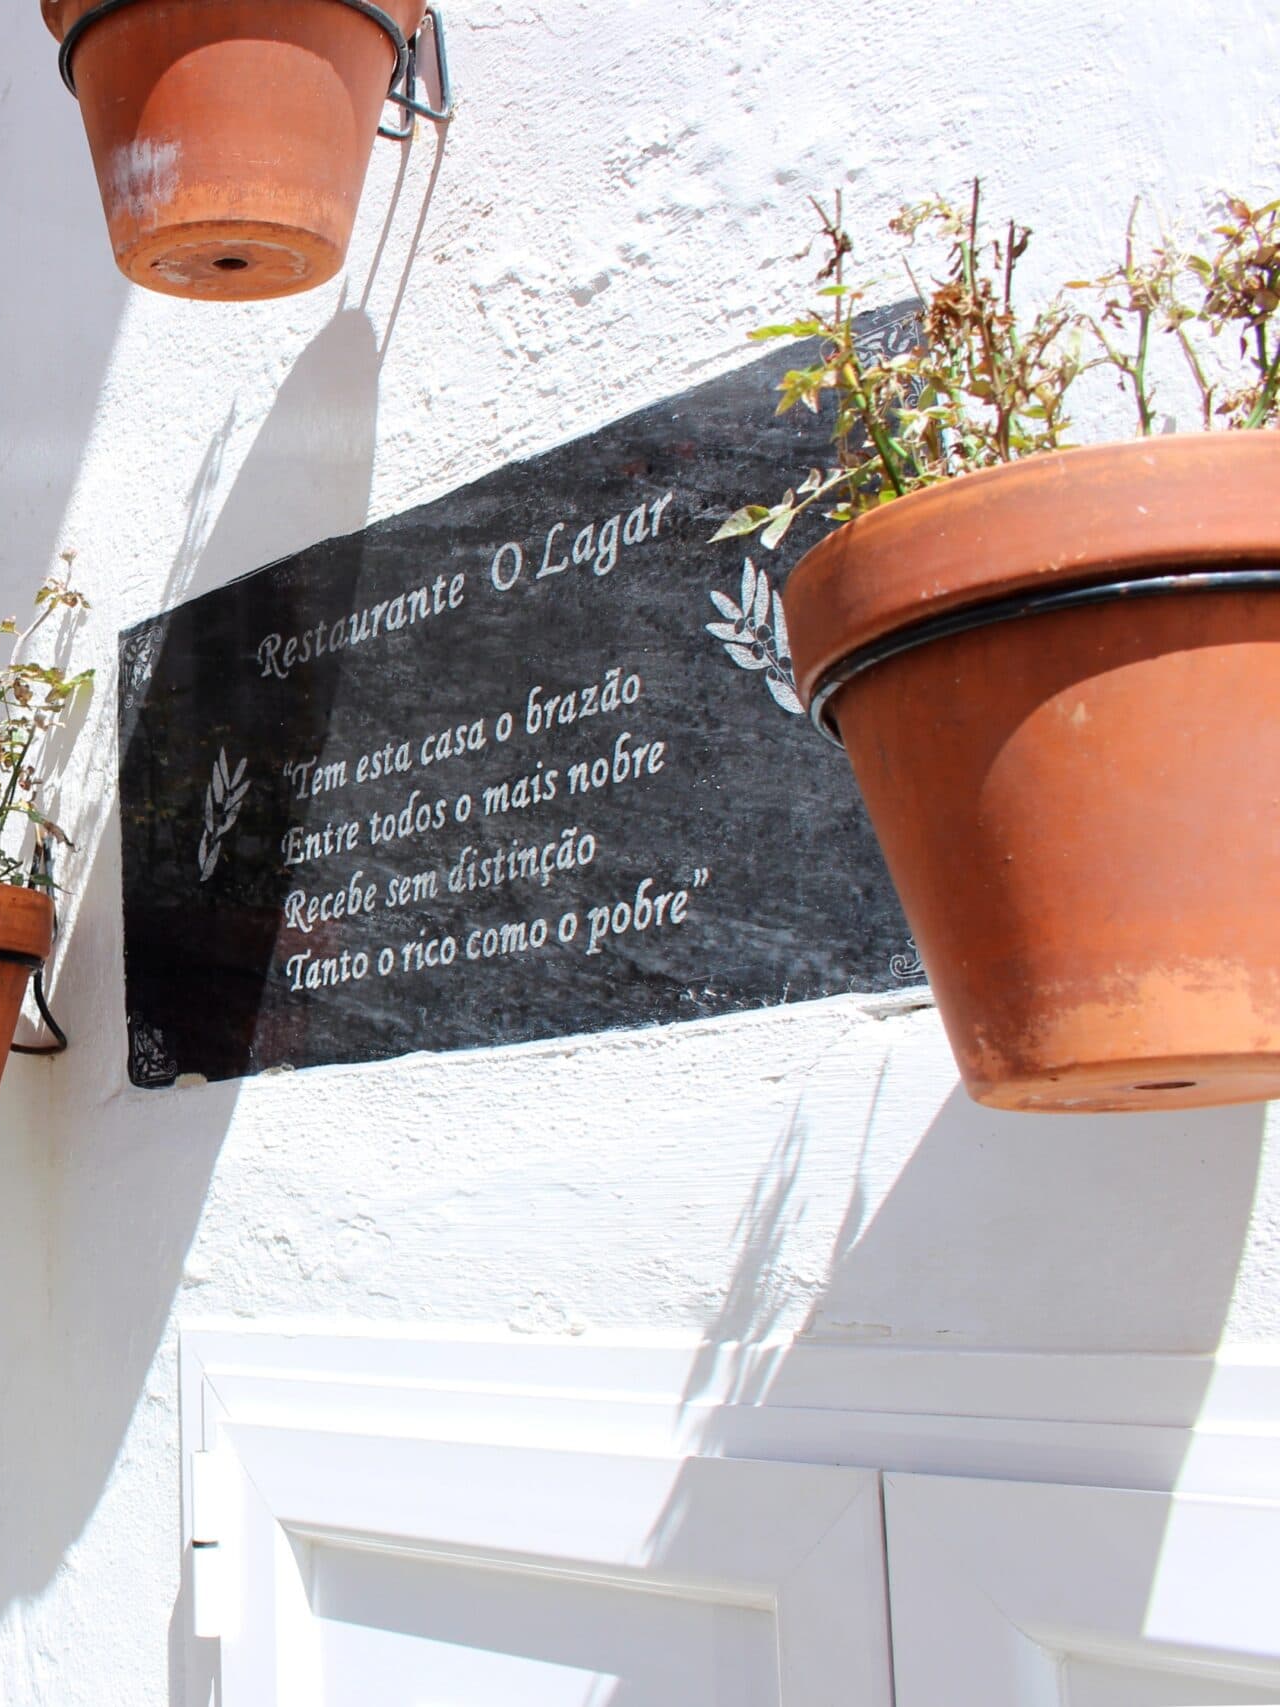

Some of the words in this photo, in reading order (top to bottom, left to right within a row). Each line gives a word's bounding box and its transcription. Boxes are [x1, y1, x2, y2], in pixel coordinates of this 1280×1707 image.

[257, 572, 464, 680] Restaurante
[491, 541, 523, 591] O
[536, 491, 673, 577] Lagar
[281, 822, 358, 867] Entre
[369, 789, 446, 842] todos
[455, 793, 472, 823] o
[482, 760, 559, 816] mais
[567, 732, 666, 795] nobre
[283, 755, 347, 800] “Tem
[356, 739, 412, 783] esta
[420, 717, 486, 766] casa
[495, 711, 513, 742] o
[526, 666, 641, 735] brazão
[284, 870, 376, 934] Recebe
[386, 867, 438, 908] sem
[448, 826, 596, 888] distinção
[286, 949, 368, 992] Tanto
[377, 947, 394, 976] o
[401, 929, 456, 972] rico
[465, 919, 547, 960] como
[557, 911, 578, 943] o
